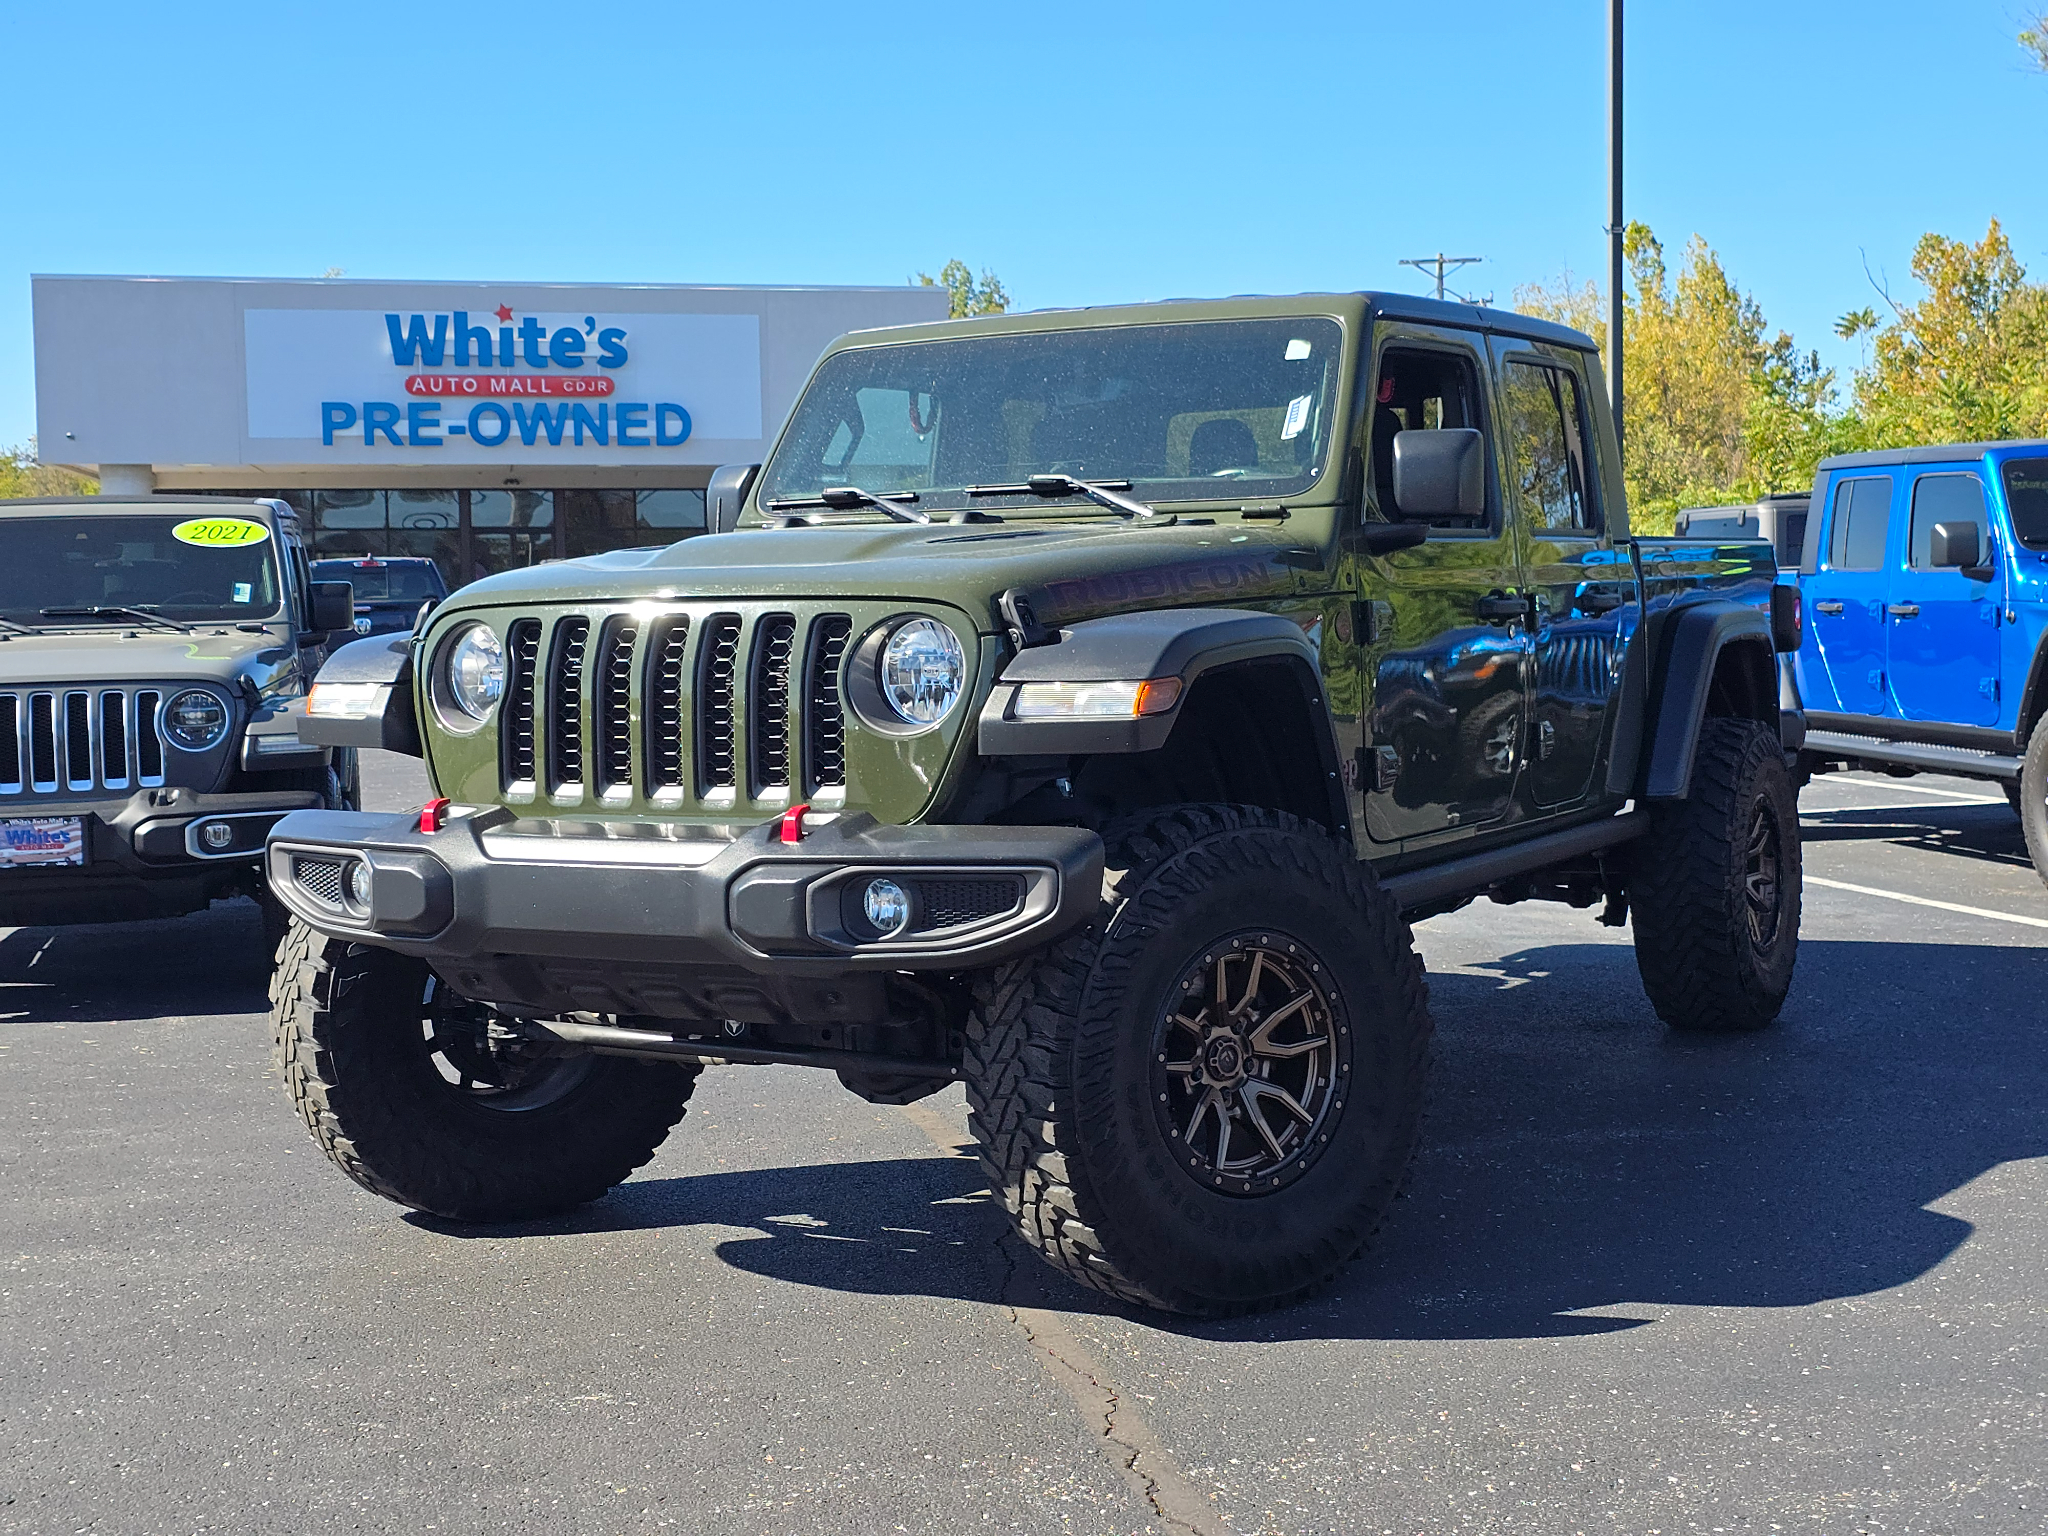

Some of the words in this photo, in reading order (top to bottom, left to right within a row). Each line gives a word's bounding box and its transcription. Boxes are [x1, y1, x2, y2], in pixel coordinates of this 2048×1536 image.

[385, 307, 629, 370] White's
[412, 376, 478, 394] AUTO
[490, 376, 552, 395] MALL
[563, 380, 609, 393] CDJR
[321, 401, 693, 447] PRE-OWNED
[190, 525, 253, 540] 2021
[1044, 560, 1272, 609] RUBICON
[5, 829, 71, 845] White's
